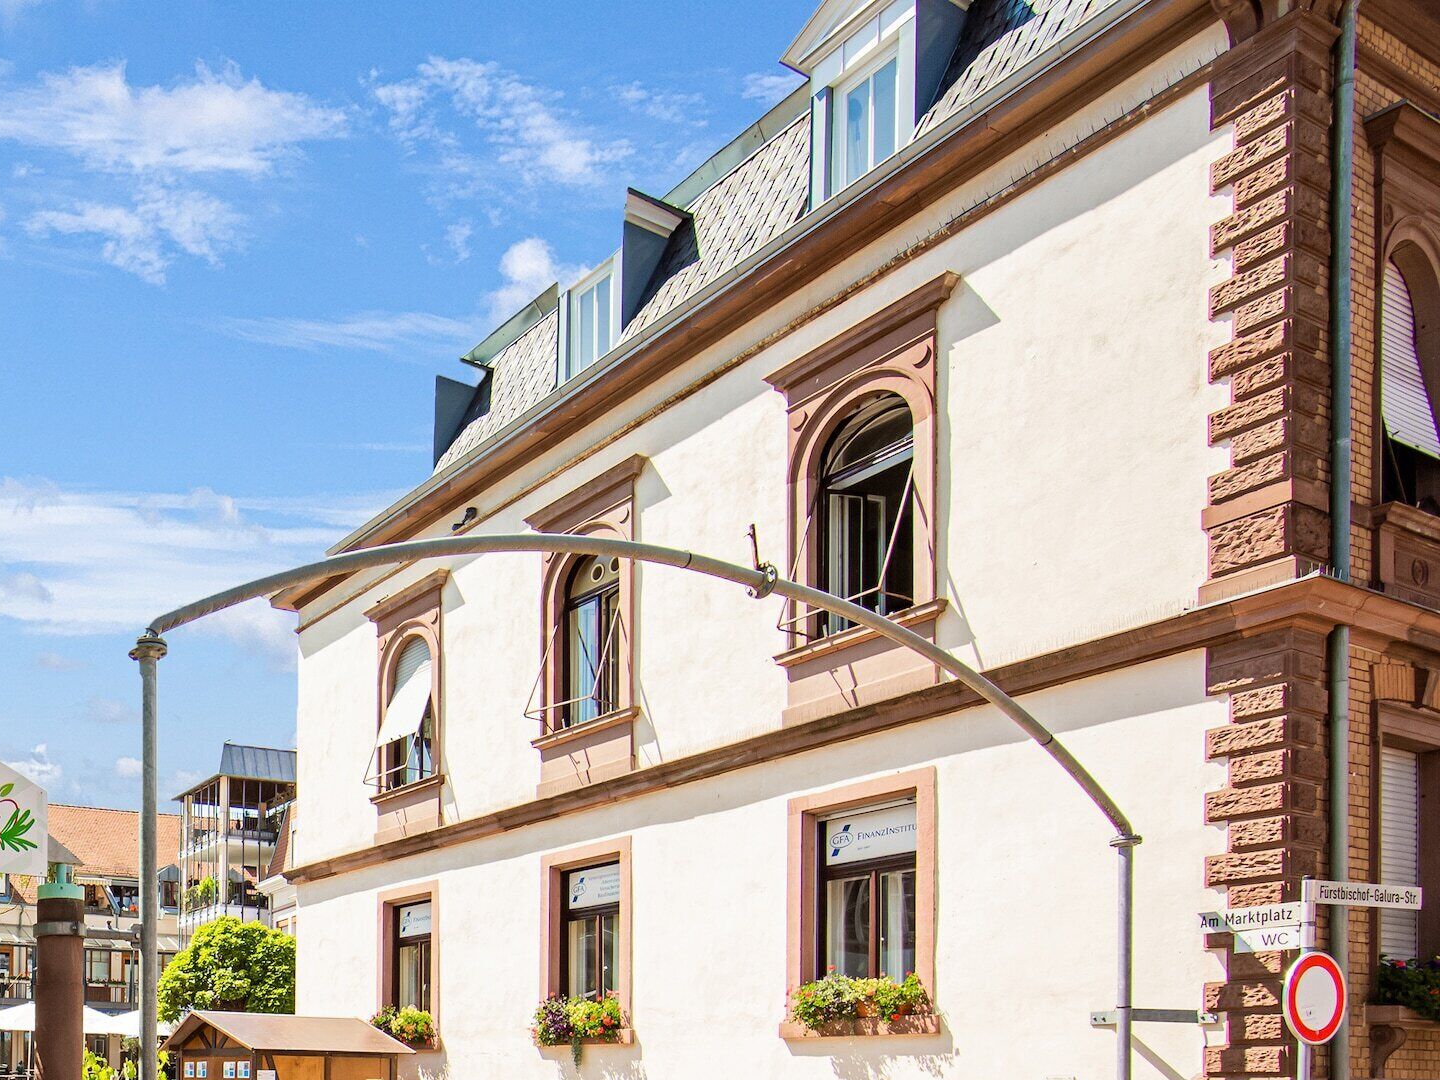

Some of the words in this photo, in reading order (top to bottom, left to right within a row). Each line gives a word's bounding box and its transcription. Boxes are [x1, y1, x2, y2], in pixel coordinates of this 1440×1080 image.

[832, 835, 850, 845] GFA
[1320, 885, 1418, 905] Fürstbischof-Galura-Str.
[1200, 916, 1219, 928] Am
[1225, 908, 1293, 927] Marktplatz
[1262, 932, 1289, 946] WC
